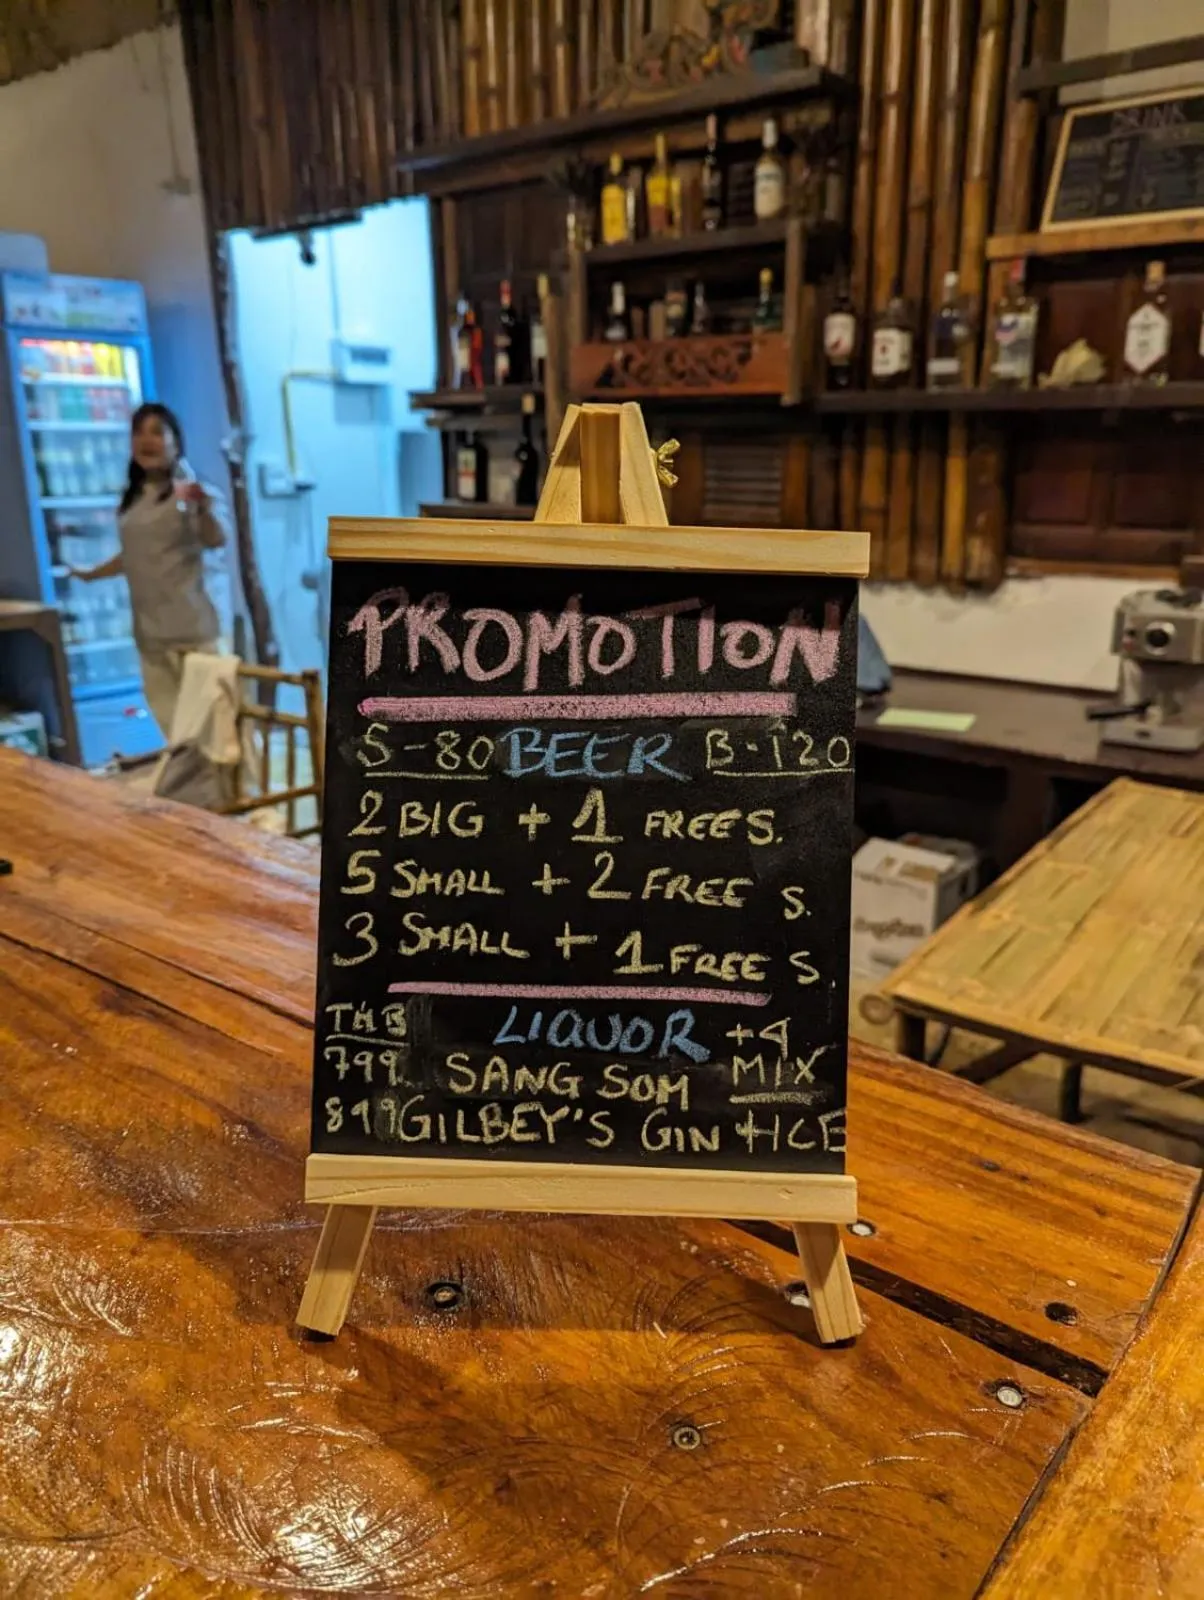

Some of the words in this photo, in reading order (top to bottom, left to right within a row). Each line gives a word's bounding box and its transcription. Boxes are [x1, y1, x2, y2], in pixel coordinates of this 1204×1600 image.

[347, 586, 841, 691] PROMOTION
[500, 727, 692, 779] BEER
[348, 790, 387, 837] 2
[399, 800, 485, 838] BIG
[518, 804, 551, 841] +
[571, 788, 623, 844] 1
[340, 850, 382, 896] 5
[390, 860, 505, 899] SMALL
[532, 863, 571, 895] +
[588, 853, 631, 900] 2
[641, 868, 754, 908] FREE
[332, 912, 378, 967] 3
[399, 913, 530, 960] SMALL
[555, 921, 598, 960] +
[613, 930, 664, 975] 1
[669, 944, 771, 982] FREE
[325, 1001, 407, 1037] THB
[493, 1006, 711, 1063] LIQUOR
[446, 1052, 580, 1098] SANG
[596, 1064, 689, 1110] SOM
[732, 1045, 830, 1091] MIX
[399, 1095, 616, 1148] GILBEY'S
[641, 1109, 720, 1153] GIN
